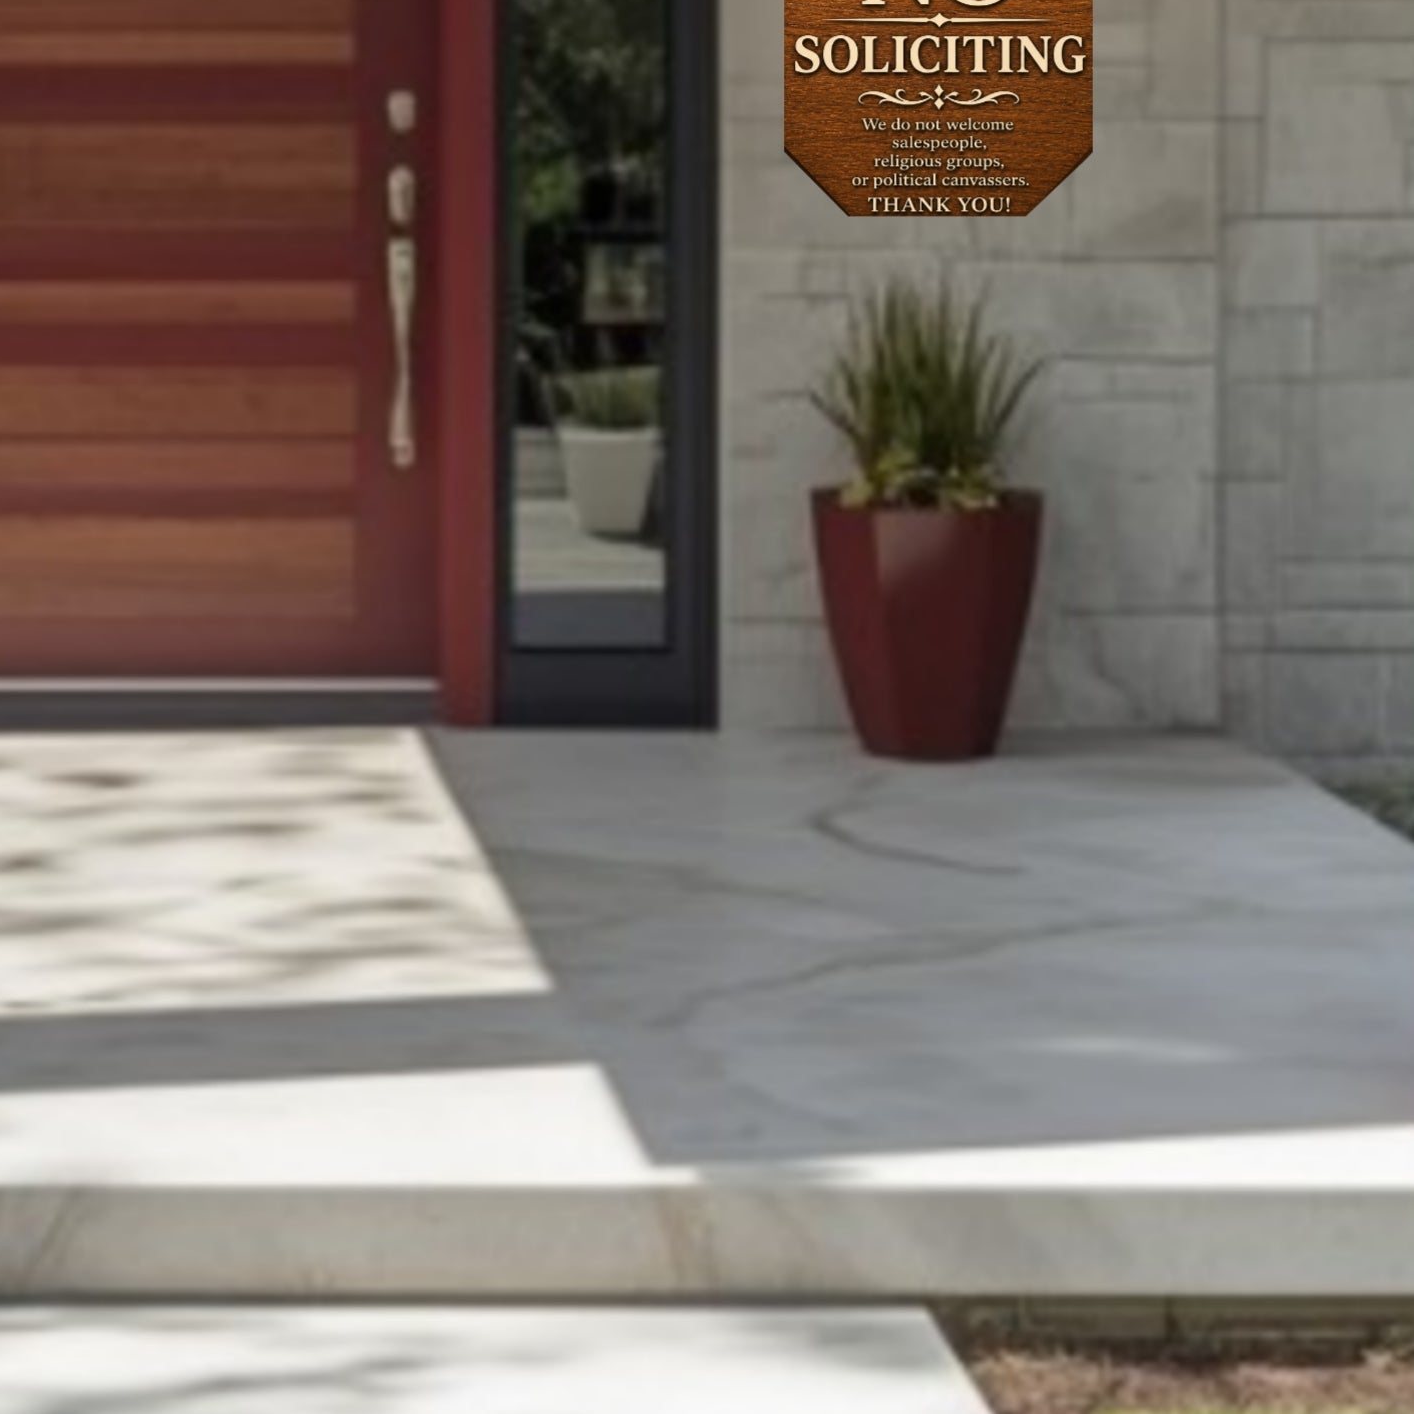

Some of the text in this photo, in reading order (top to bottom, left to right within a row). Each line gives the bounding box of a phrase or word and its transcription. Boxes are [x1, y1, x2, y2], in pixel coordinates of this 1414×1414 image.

[794, 34, 1087, 74] SOLICITING
[862, 117, 1014, 131] We do not welcome
[892, 135, 987, 152] salespeople,
[874, 153, 1005, 171] religious groups,
[851, 172, 1030, 190] or political canvassers.
[867, 196, 1010, 213] THANK YOU!
